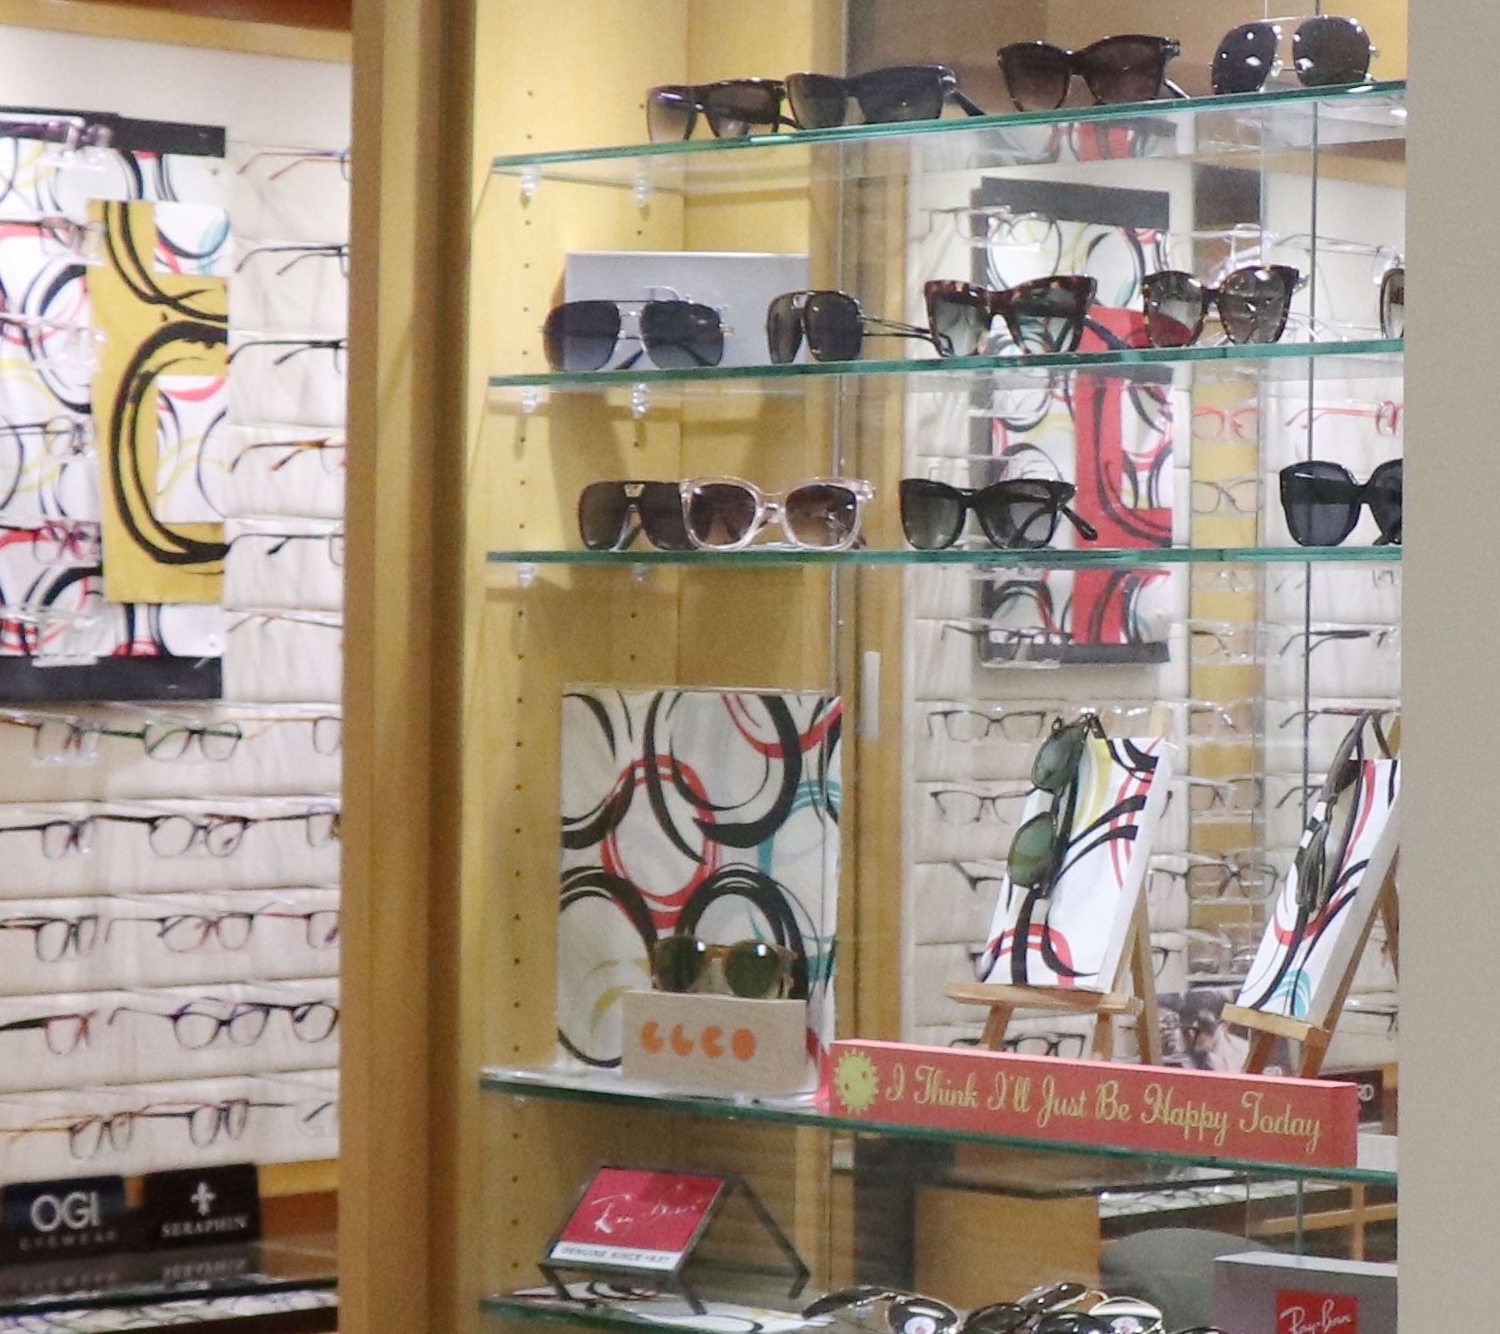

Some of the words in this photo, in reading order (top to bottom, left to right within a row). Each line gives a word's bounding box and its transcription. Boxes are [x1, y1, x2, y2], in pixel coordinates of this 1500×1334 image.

[885, 1066, 905, 1101] I
[915, 1066, 979, 1109] Think
[1037, 1075, 1087, 1128] Just
[1095, 1080, 1132, 1123] Be
[1140, 1083, 1230, 1146] Happy
[1239, 1090, 1323, 1154] Today
[30, 1191, 99, 1233] OGI
